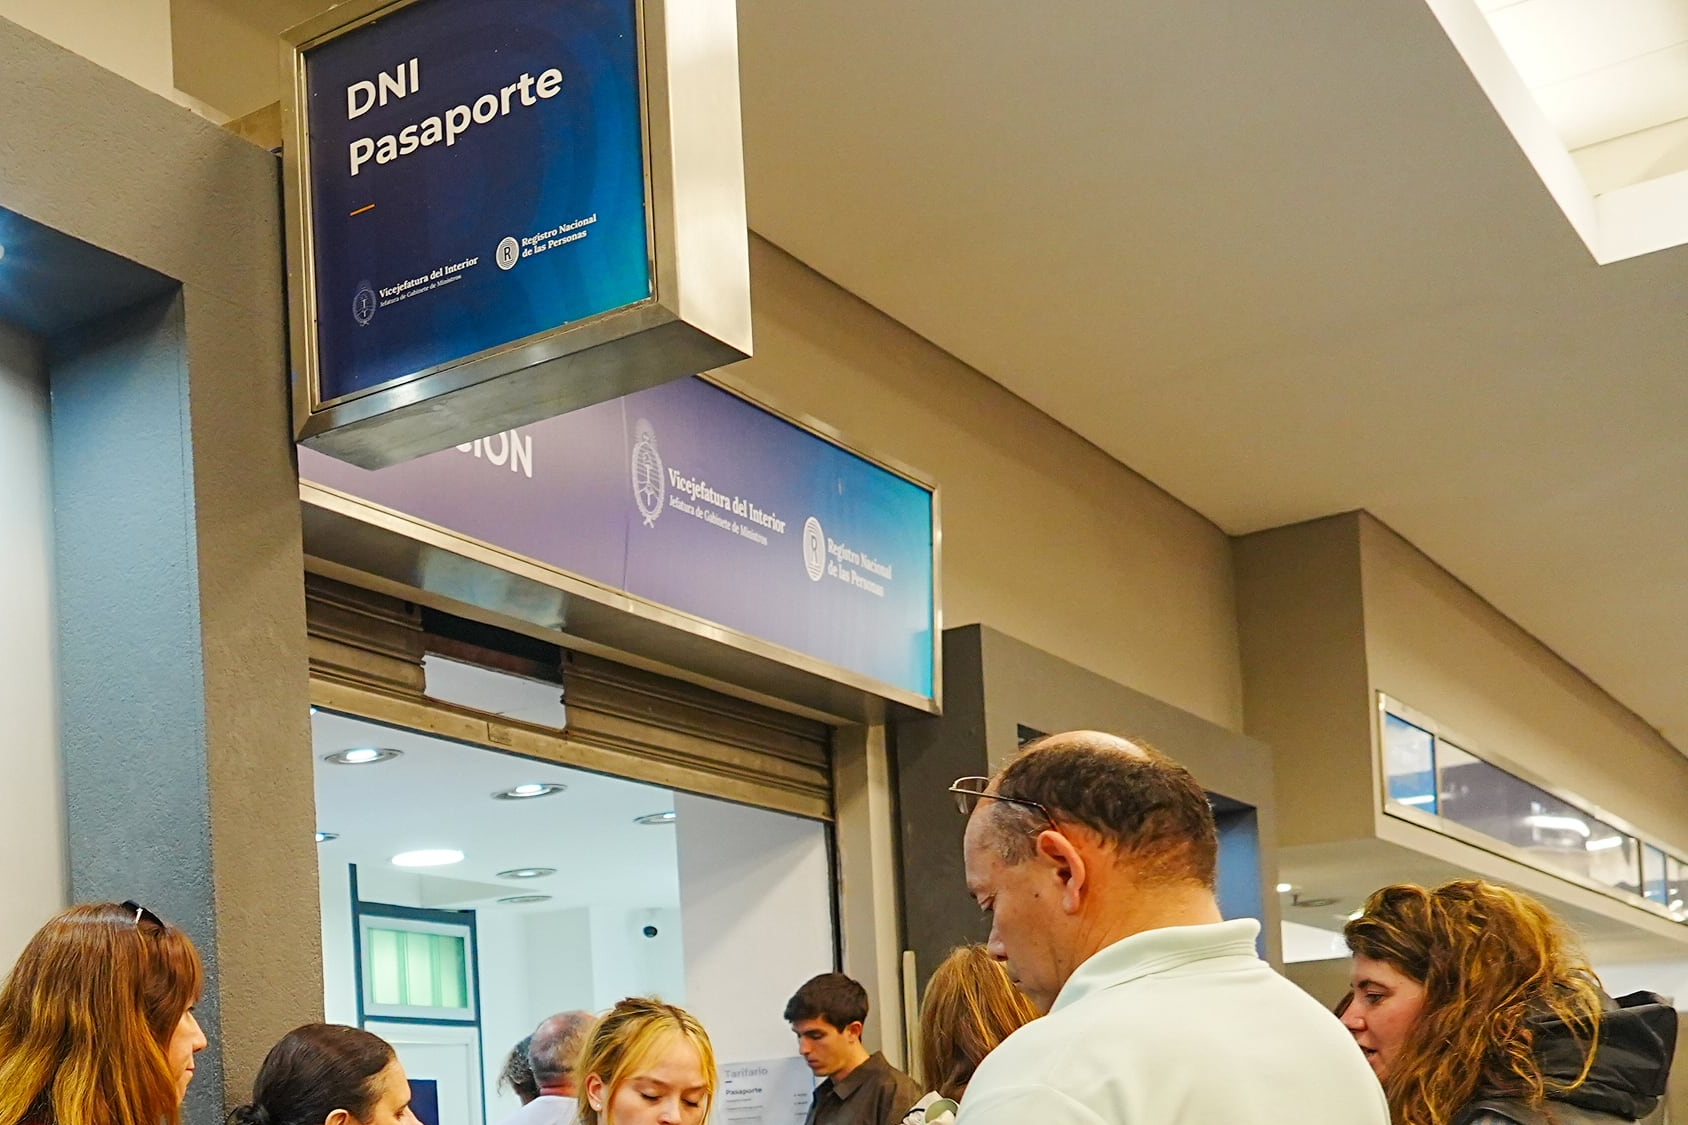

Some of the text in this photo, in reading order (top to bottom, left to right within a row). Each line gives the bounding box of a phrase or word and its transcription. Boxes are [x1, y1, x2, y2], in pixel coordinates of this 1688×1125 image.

[347, 57, 419, 120] DNI
[349, 68, 563, 177] Pasaporte
[522, 213, 597, 247] Registro Nacional
[522, 230, 587, 258] de las Personas
[379, 257, 479, 298] Vicejefatura del Interior
[668, 467, 786, 534] Vicejefatura del Interior
